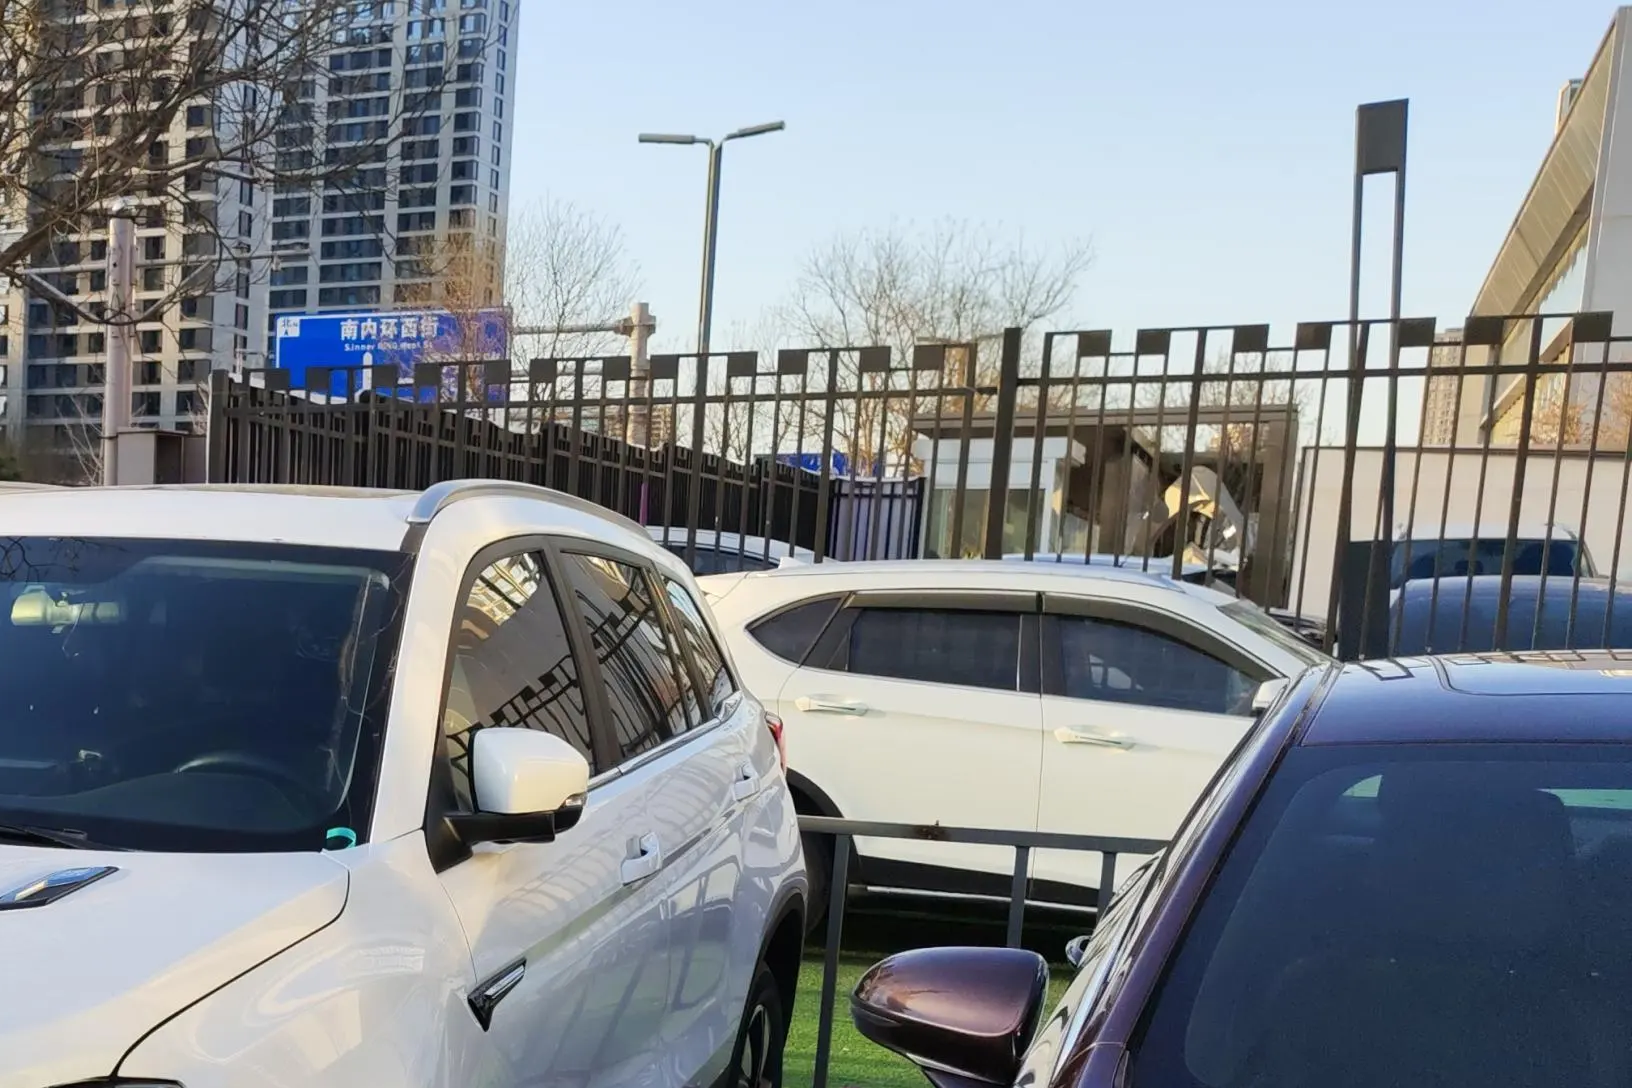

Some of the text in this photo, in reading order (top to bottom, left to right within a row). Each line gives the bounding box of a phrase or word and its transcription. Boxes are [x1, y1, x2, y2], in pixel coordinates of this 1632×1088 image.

[340, 317, 439, 341] 南内环西街
